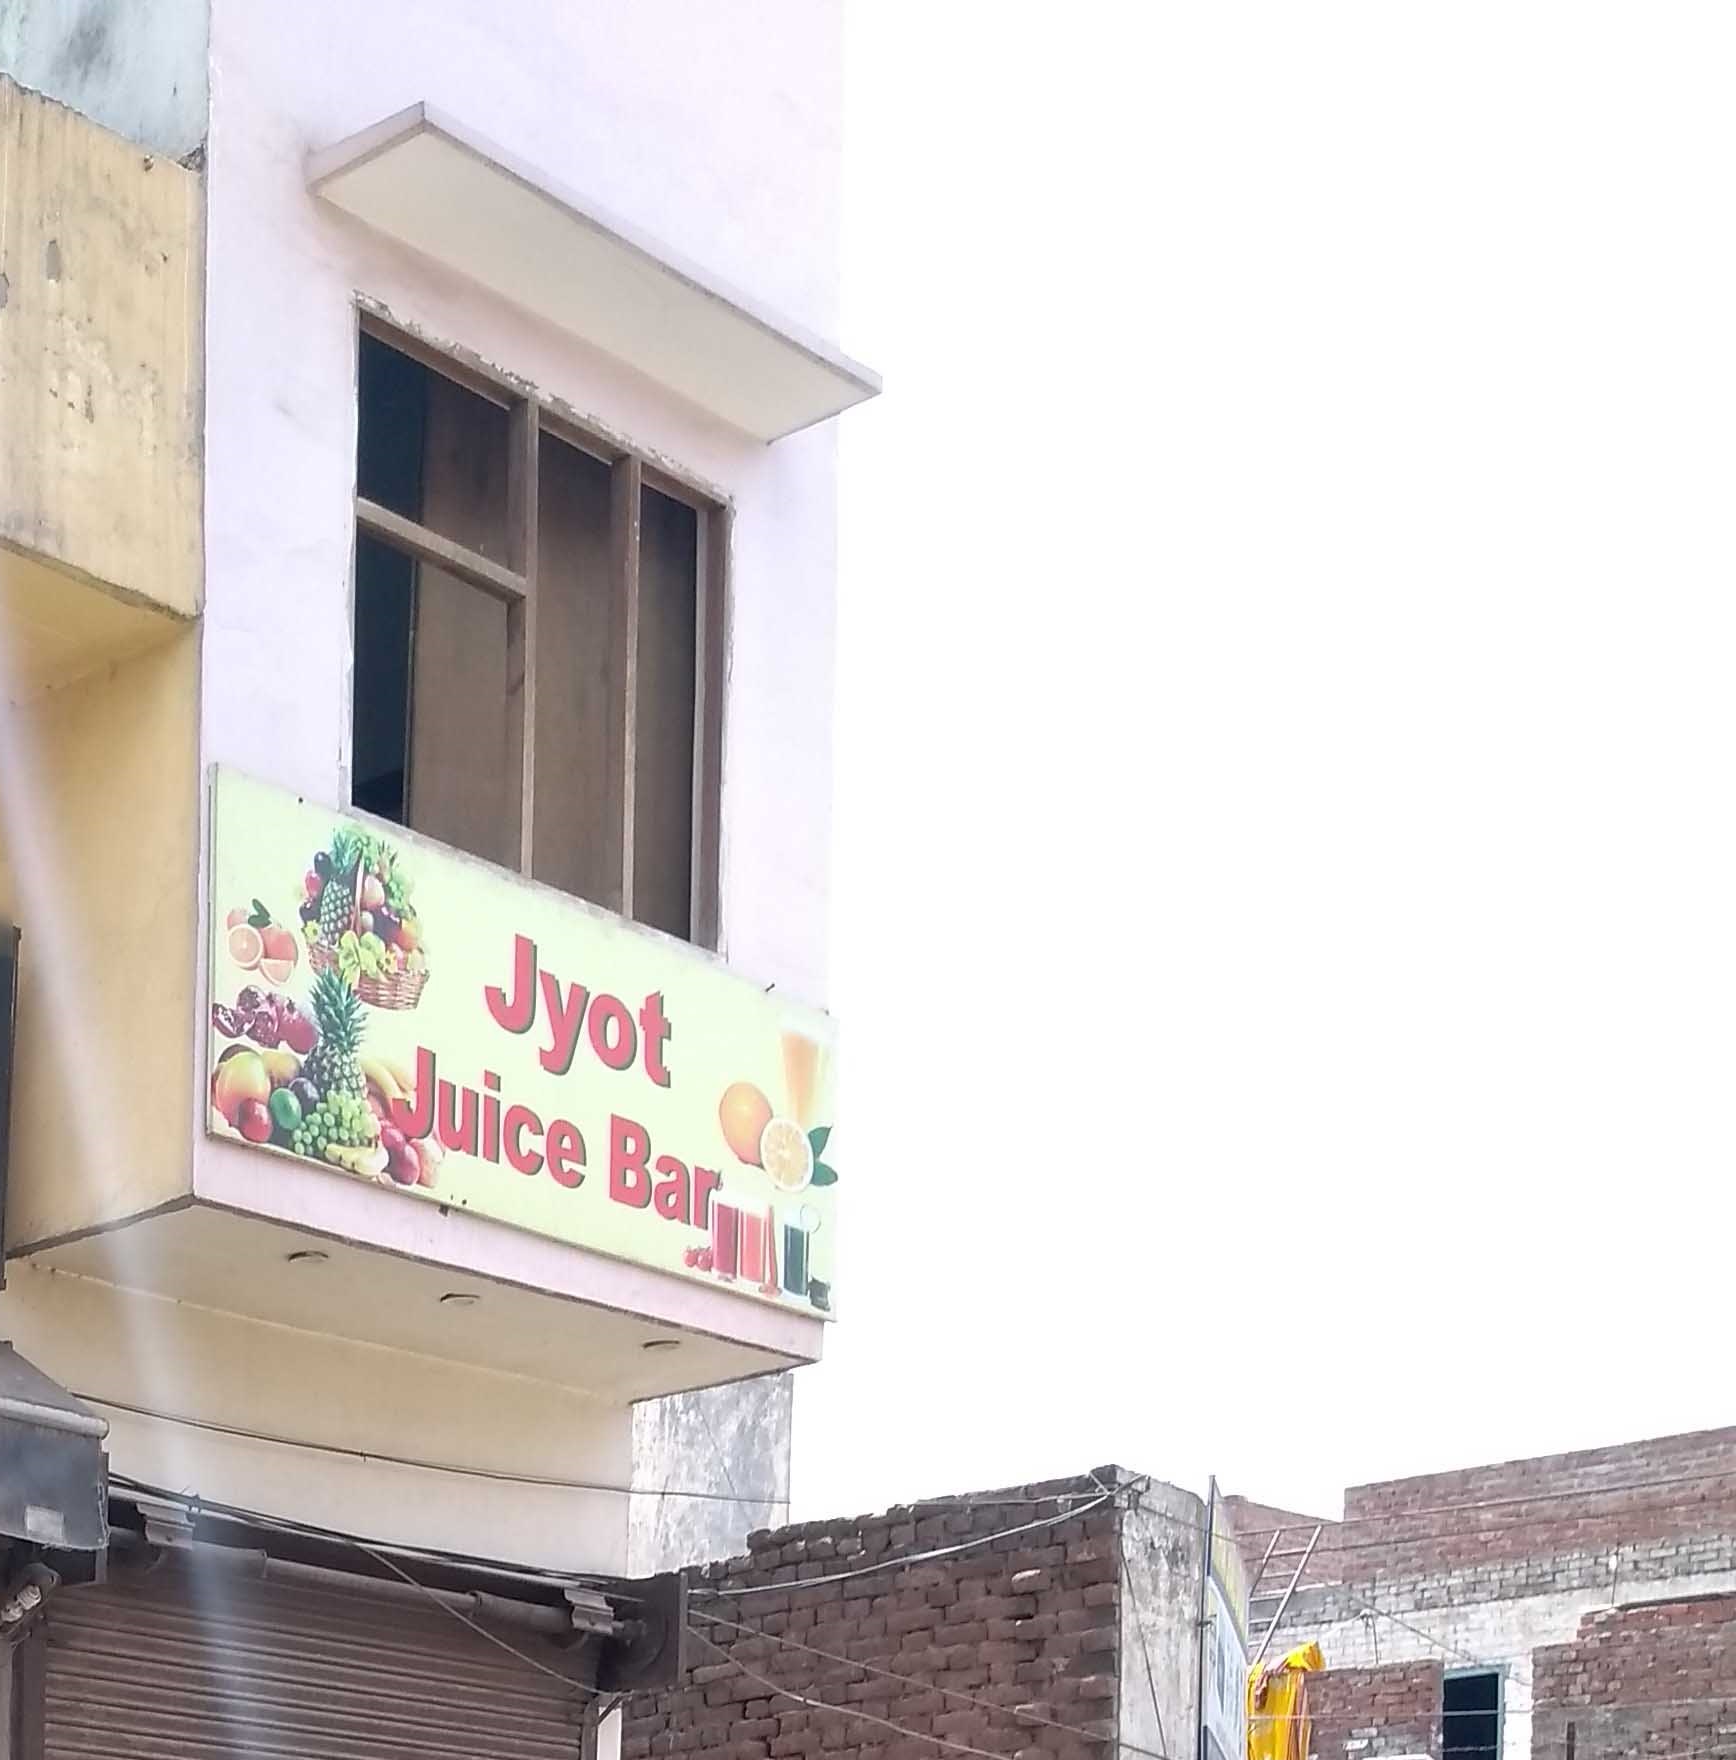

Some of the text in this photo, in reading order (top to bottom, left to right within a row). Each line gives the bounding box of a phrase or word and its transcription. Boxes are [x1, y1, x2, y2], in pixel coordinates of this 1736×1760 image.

[483, 932, 672, 1089] Jyot
[391, 1045, 722, 1231] Juice Bar
